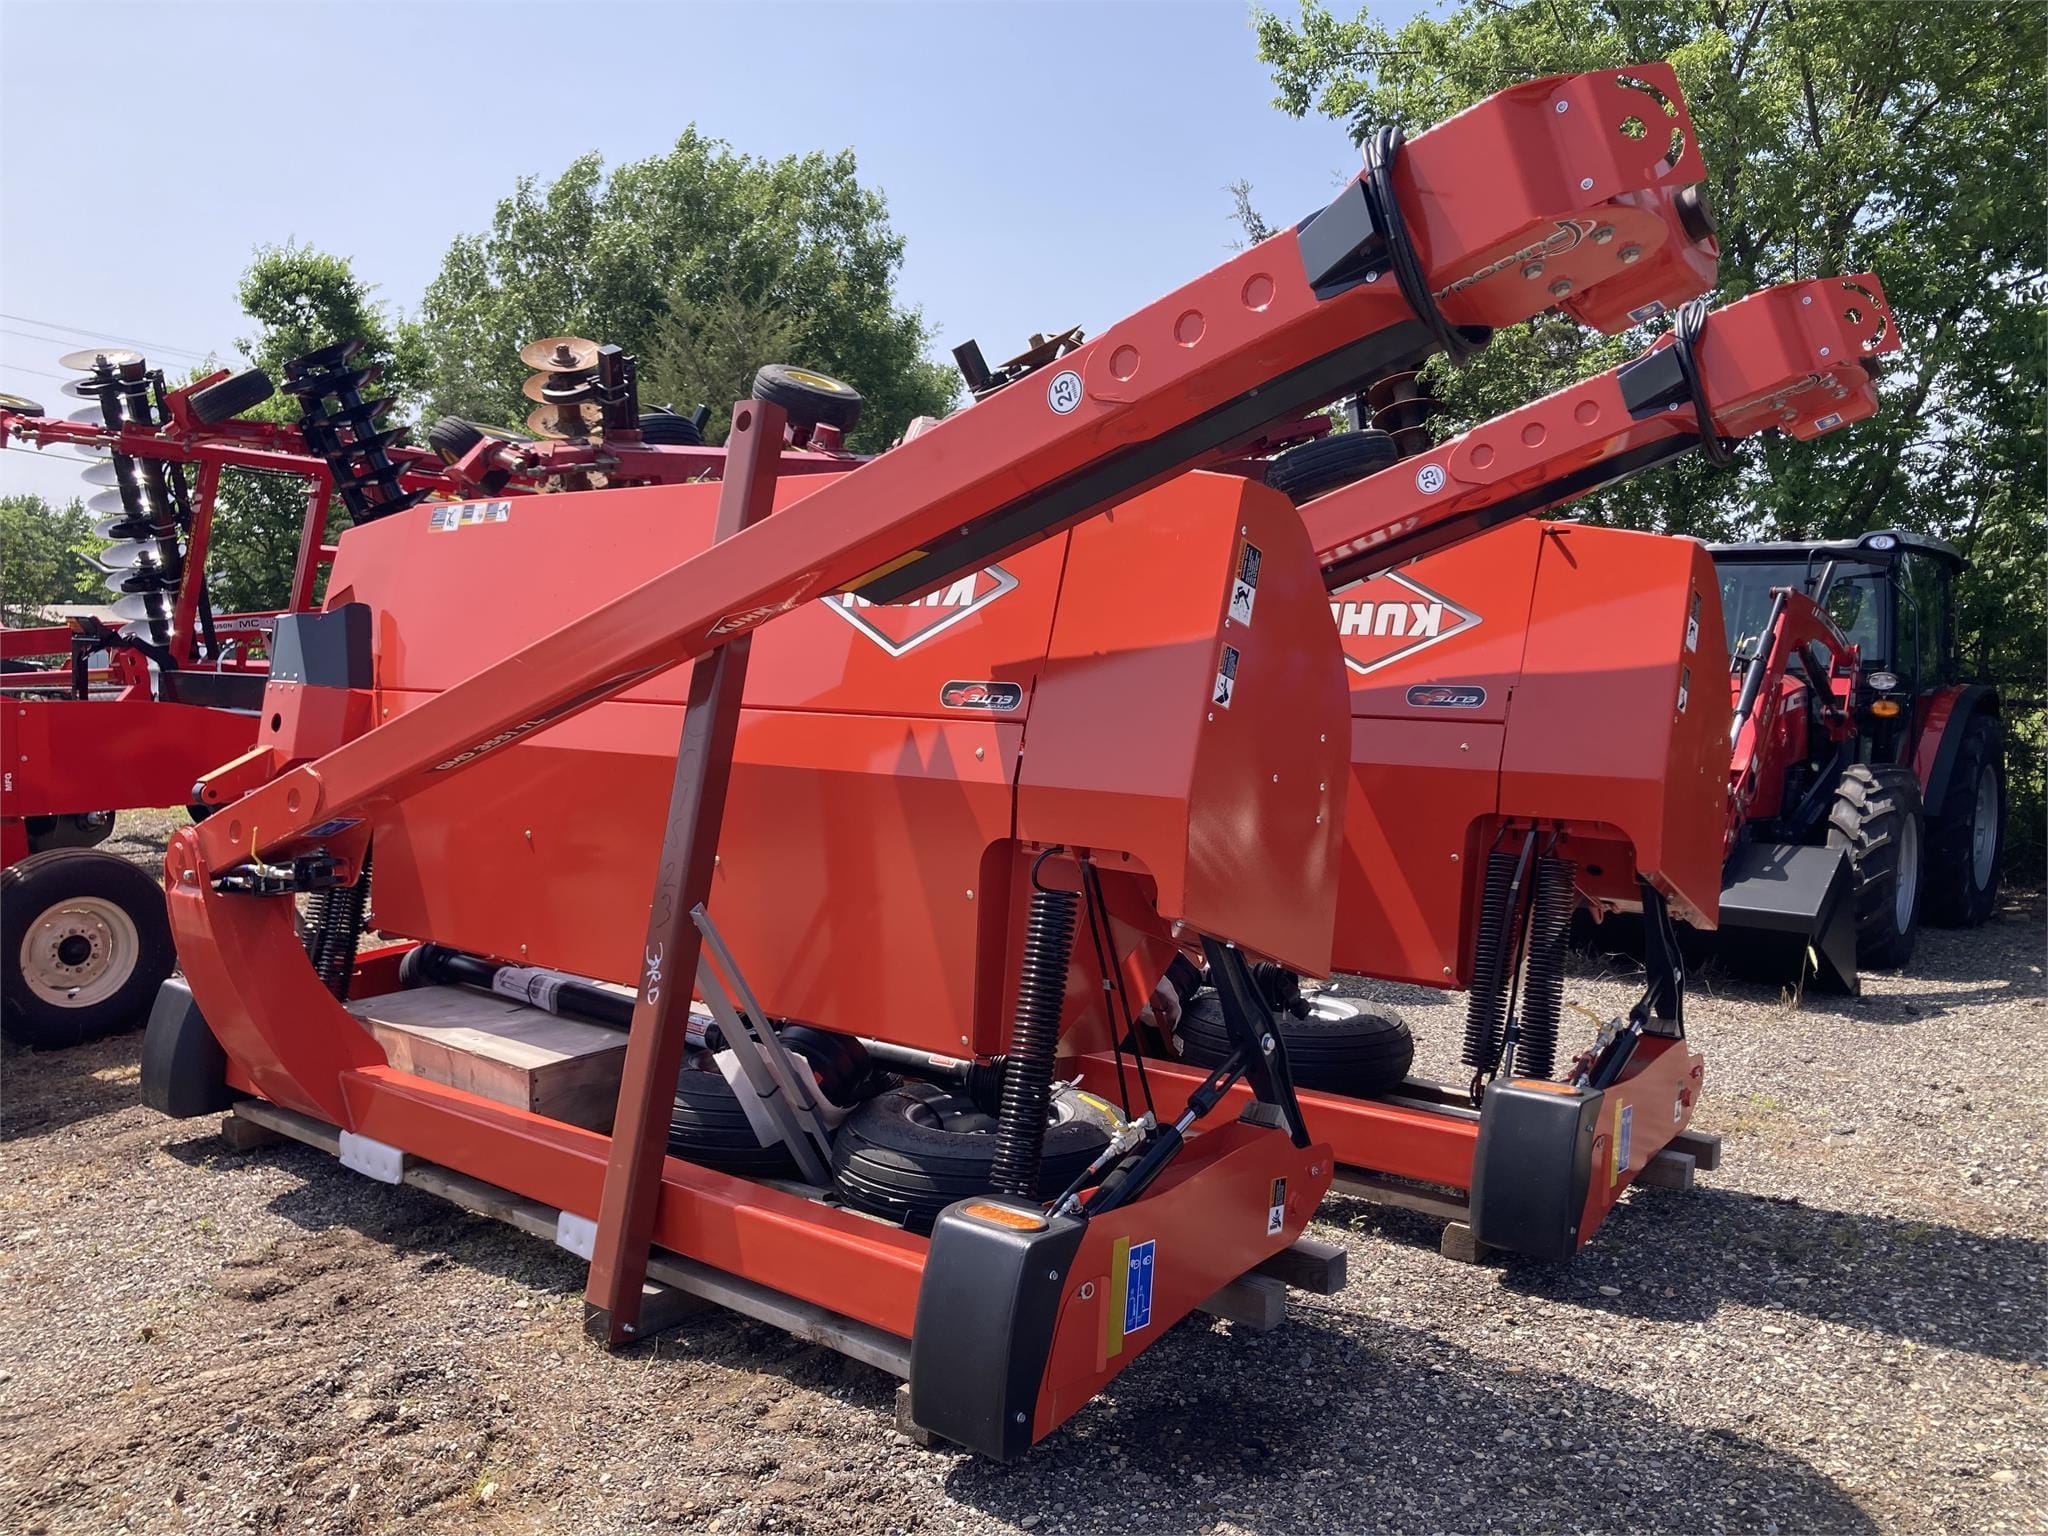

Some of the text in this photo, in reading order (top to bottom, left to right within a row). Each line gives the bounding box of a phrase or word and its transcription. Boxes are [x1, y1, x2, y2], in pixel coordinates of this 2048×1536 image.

[1432, 228, 1569, 300] YRODINE
[1054, 380, 1073, 407] 25
[1421, 470, 1437, 489] 25
[239, 619, 260, 629] MC
[714, 607, 775, 635] KUHN
[966, 693, 1014, 705] ELITE
[1432, 695, 1479, 703] ELITE
[515, 718, 547, 730] TL
